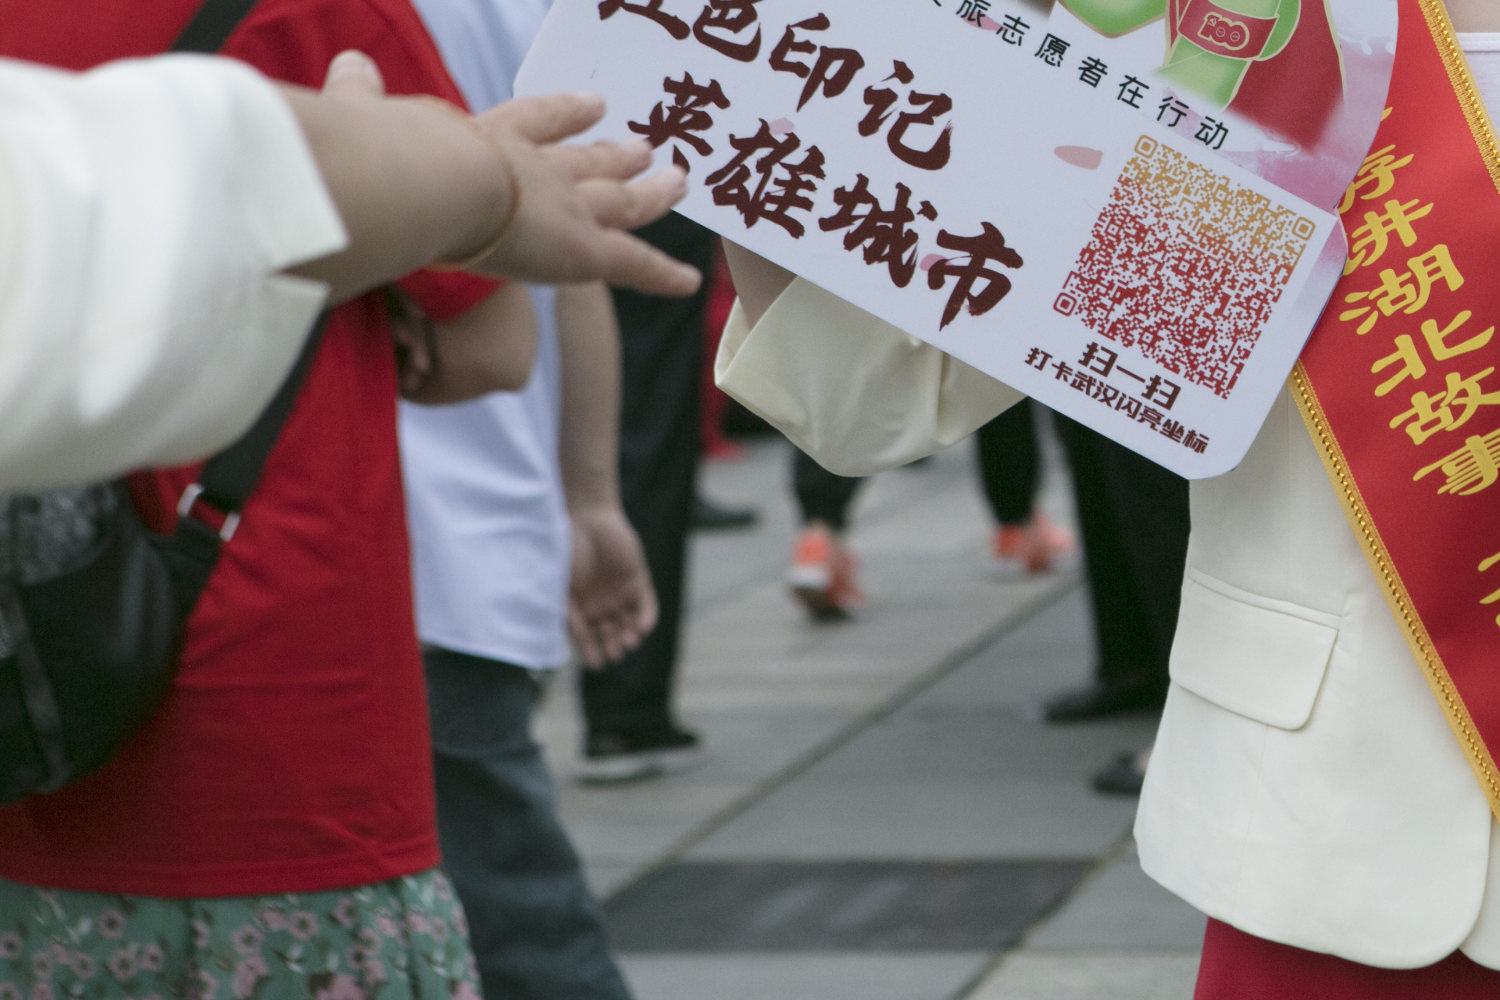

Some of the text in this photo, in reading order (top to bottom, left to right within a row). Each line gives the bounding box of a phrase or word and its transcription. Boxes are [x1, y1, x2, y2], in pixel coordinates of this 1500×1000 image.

[627, 71, 1026, 332] 英雄城市
[1025, 346, 1211, 455] 打卡武汉闪亮坐标
[1079, 341, 1182, 411] 扫一扫
